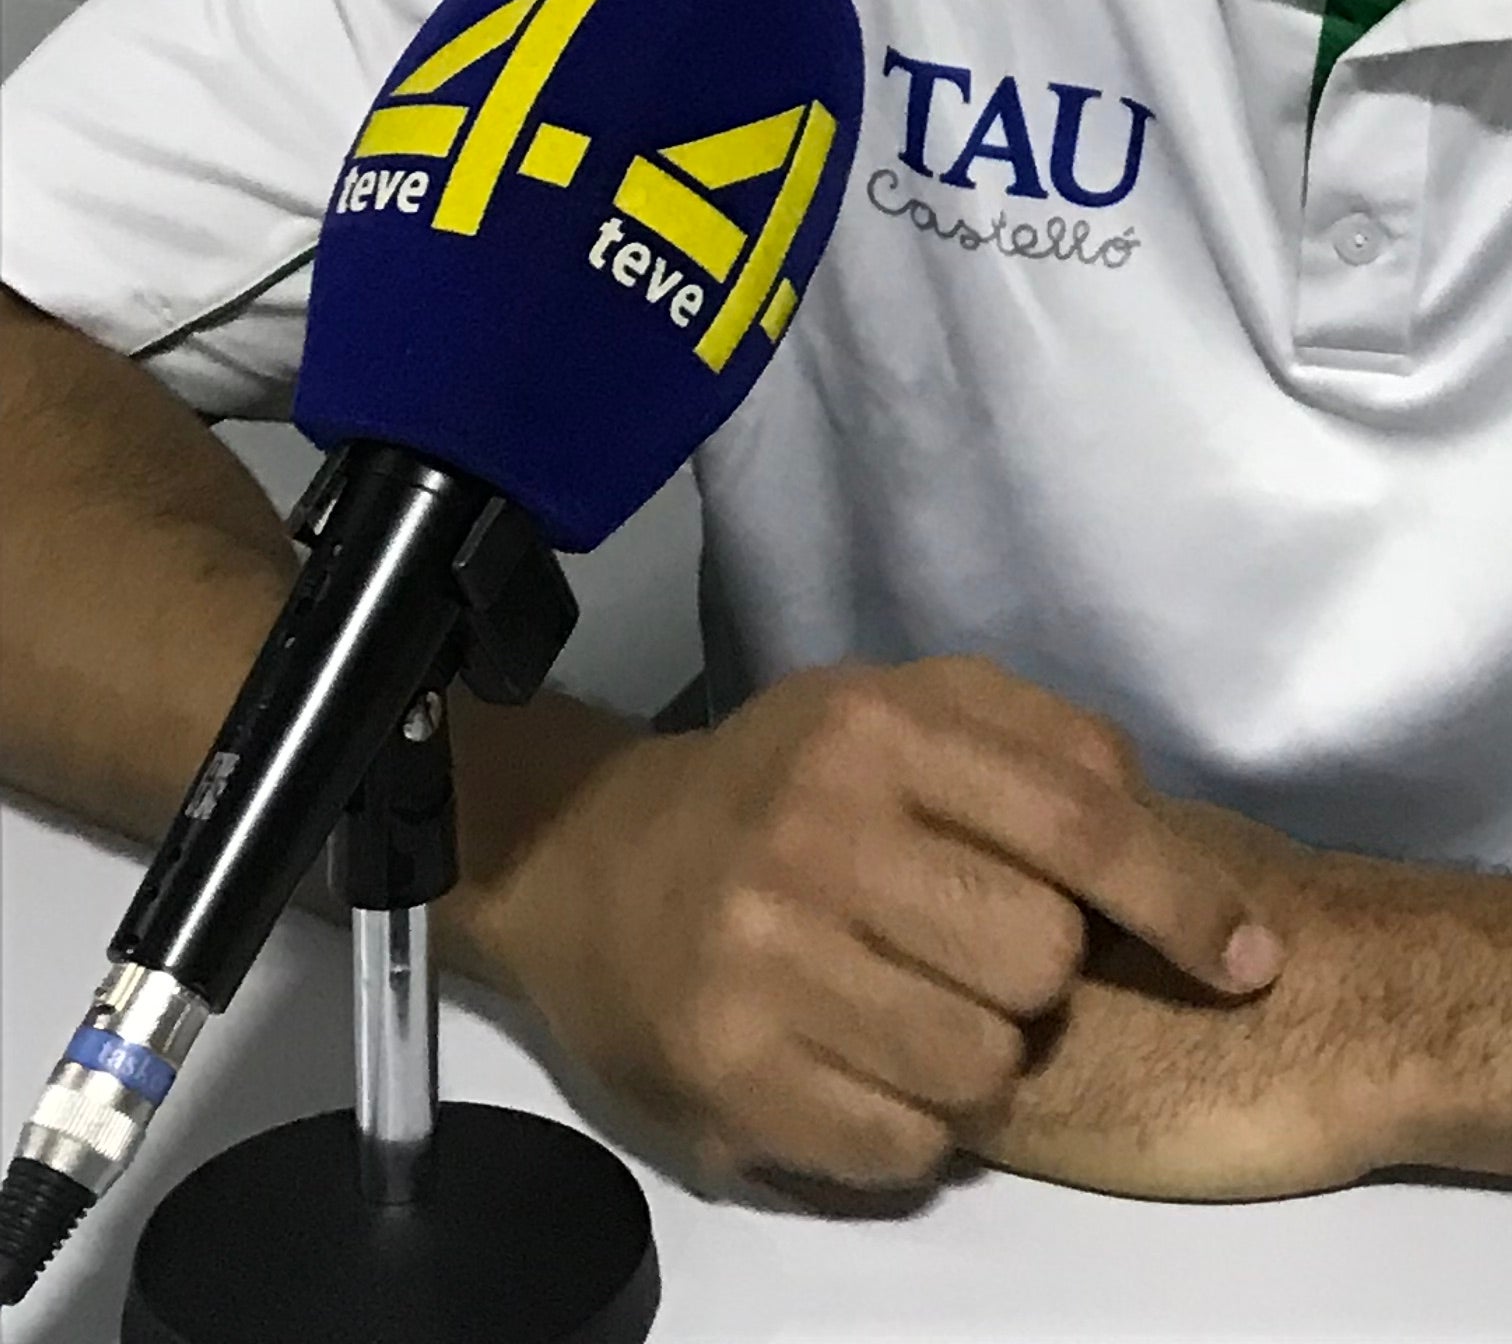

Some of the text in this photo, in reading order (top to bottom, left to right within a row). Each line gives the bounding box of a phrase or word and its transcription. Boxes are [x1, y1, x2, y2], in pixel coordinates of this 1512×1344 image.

[883, 46, 1156, 208] TAU
[337, 165, 429, 215] teve
[867, 169, 1141, 268] Castelló
[587, 216, 704, 328] teve
